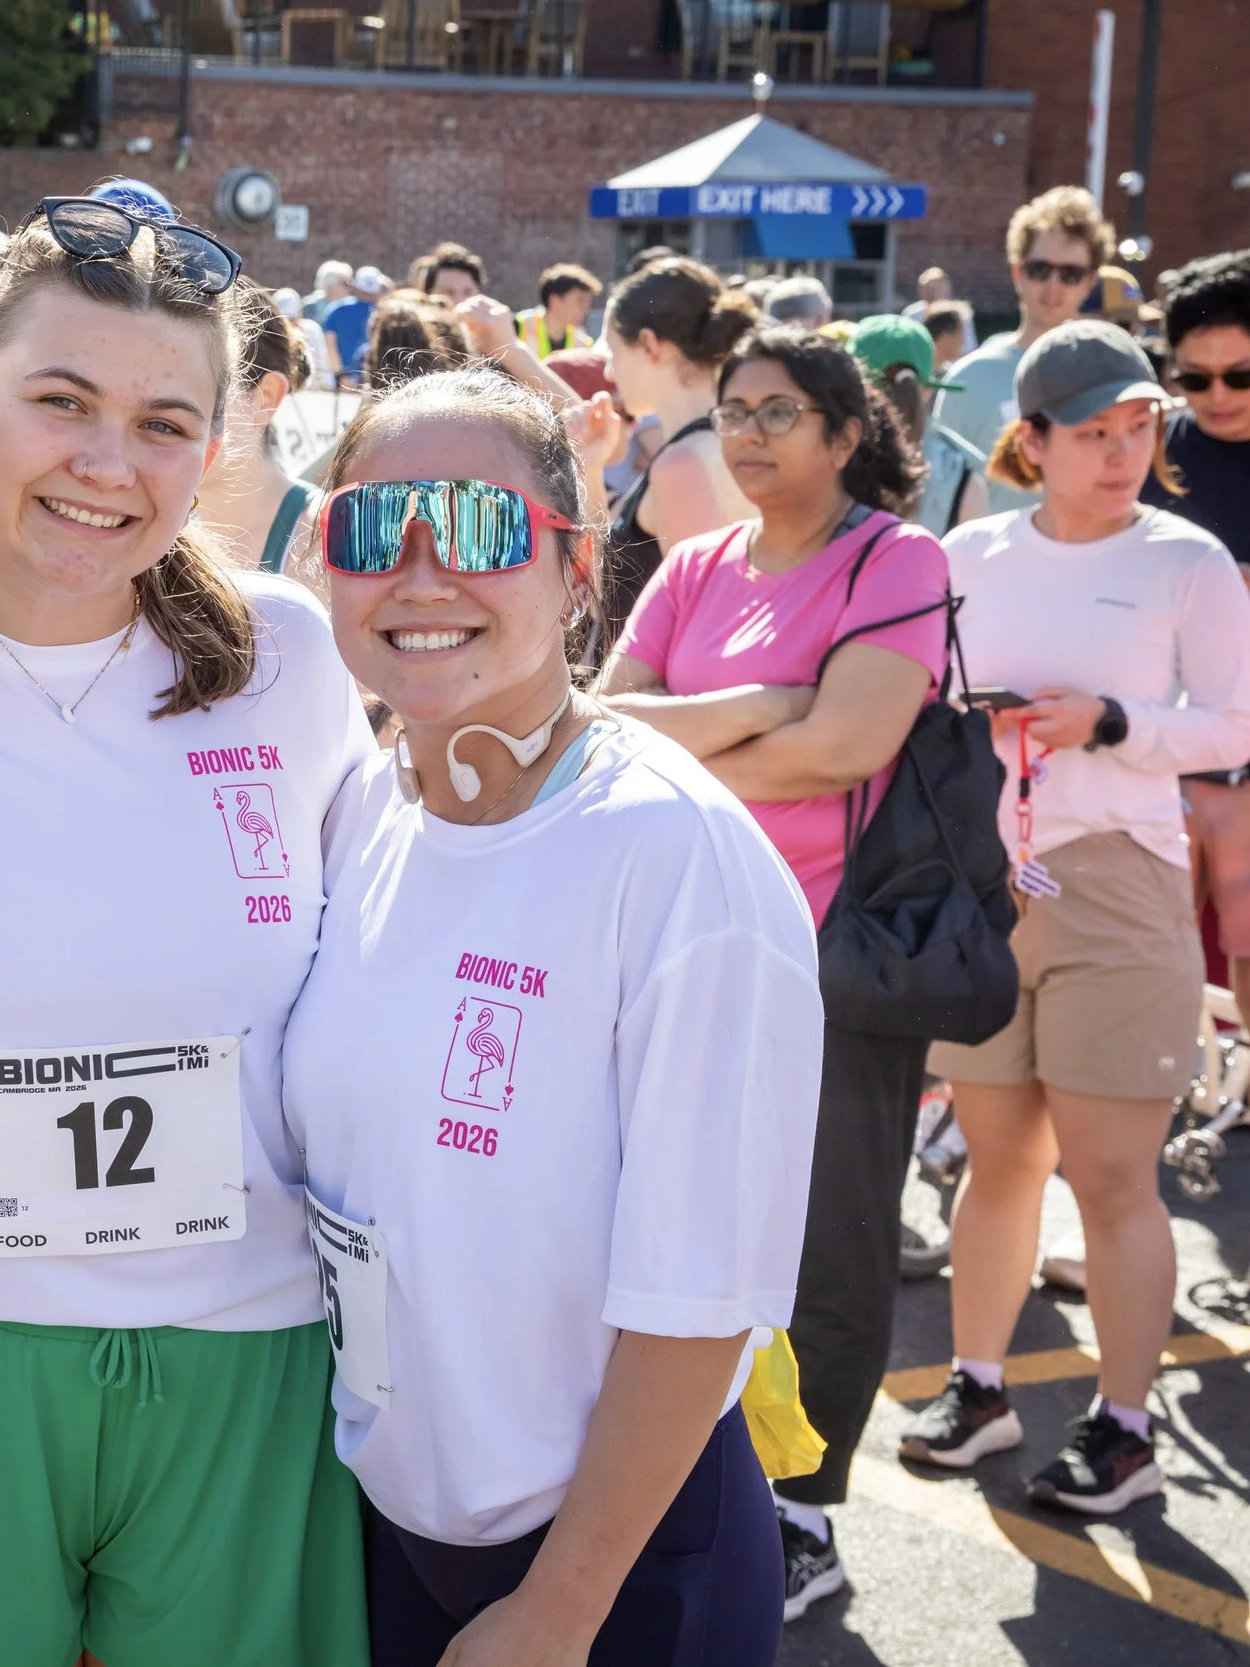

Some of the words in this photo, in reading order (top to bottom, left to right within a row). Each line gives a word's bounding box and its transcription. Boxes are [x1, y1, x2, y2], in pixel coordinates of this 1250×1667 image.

[617, 189, 659, 216] EXIT
[697, 186, 755, 214] EXIT
[760, 186, 831, 214] HERE
[187, 746, 255, 776] BIONIC
[257, 745, 284, 770] 5K
[213, 787, 223, 800] A
[245, 895, 292, 924] 2026
[455, 952, 518, 991] BIONIC
[519, 966, 549, 998] 5K
[457, 996, 467, 1012] A
[178, 1044, 209, 1057] 5K&
[65, 1084, 87, 1092] 2026
[56, 1096, 155, 1190] 12
[437, 1118, 499, 1157] 2026
[85, 1227, 141, 1245] DRINK
[175, 1216, 230, 1235] DRINK
[347, 1228, 368, 1247] 5K&
